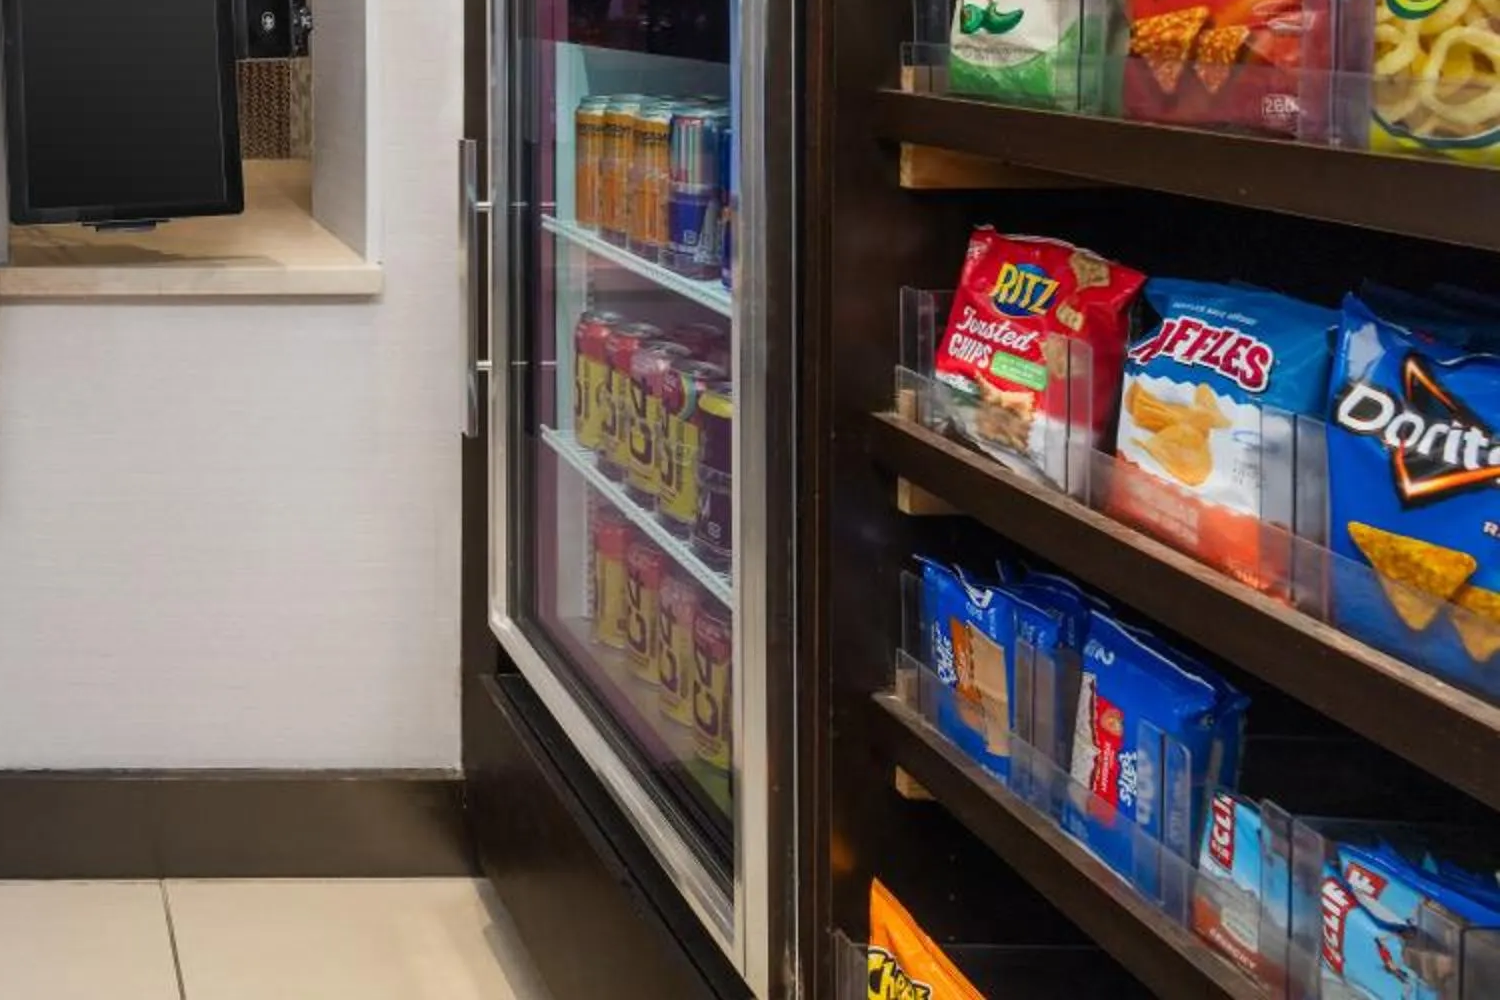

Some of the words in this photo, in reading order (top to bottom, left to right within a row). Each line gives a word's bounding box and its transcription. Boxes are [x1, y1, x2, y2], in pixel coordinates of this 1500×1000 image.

[988, 261, 1060, 316] RITZ
[947, 332, 993, 369] CHIPS
[956, 306, 1041, 352] Toasted
